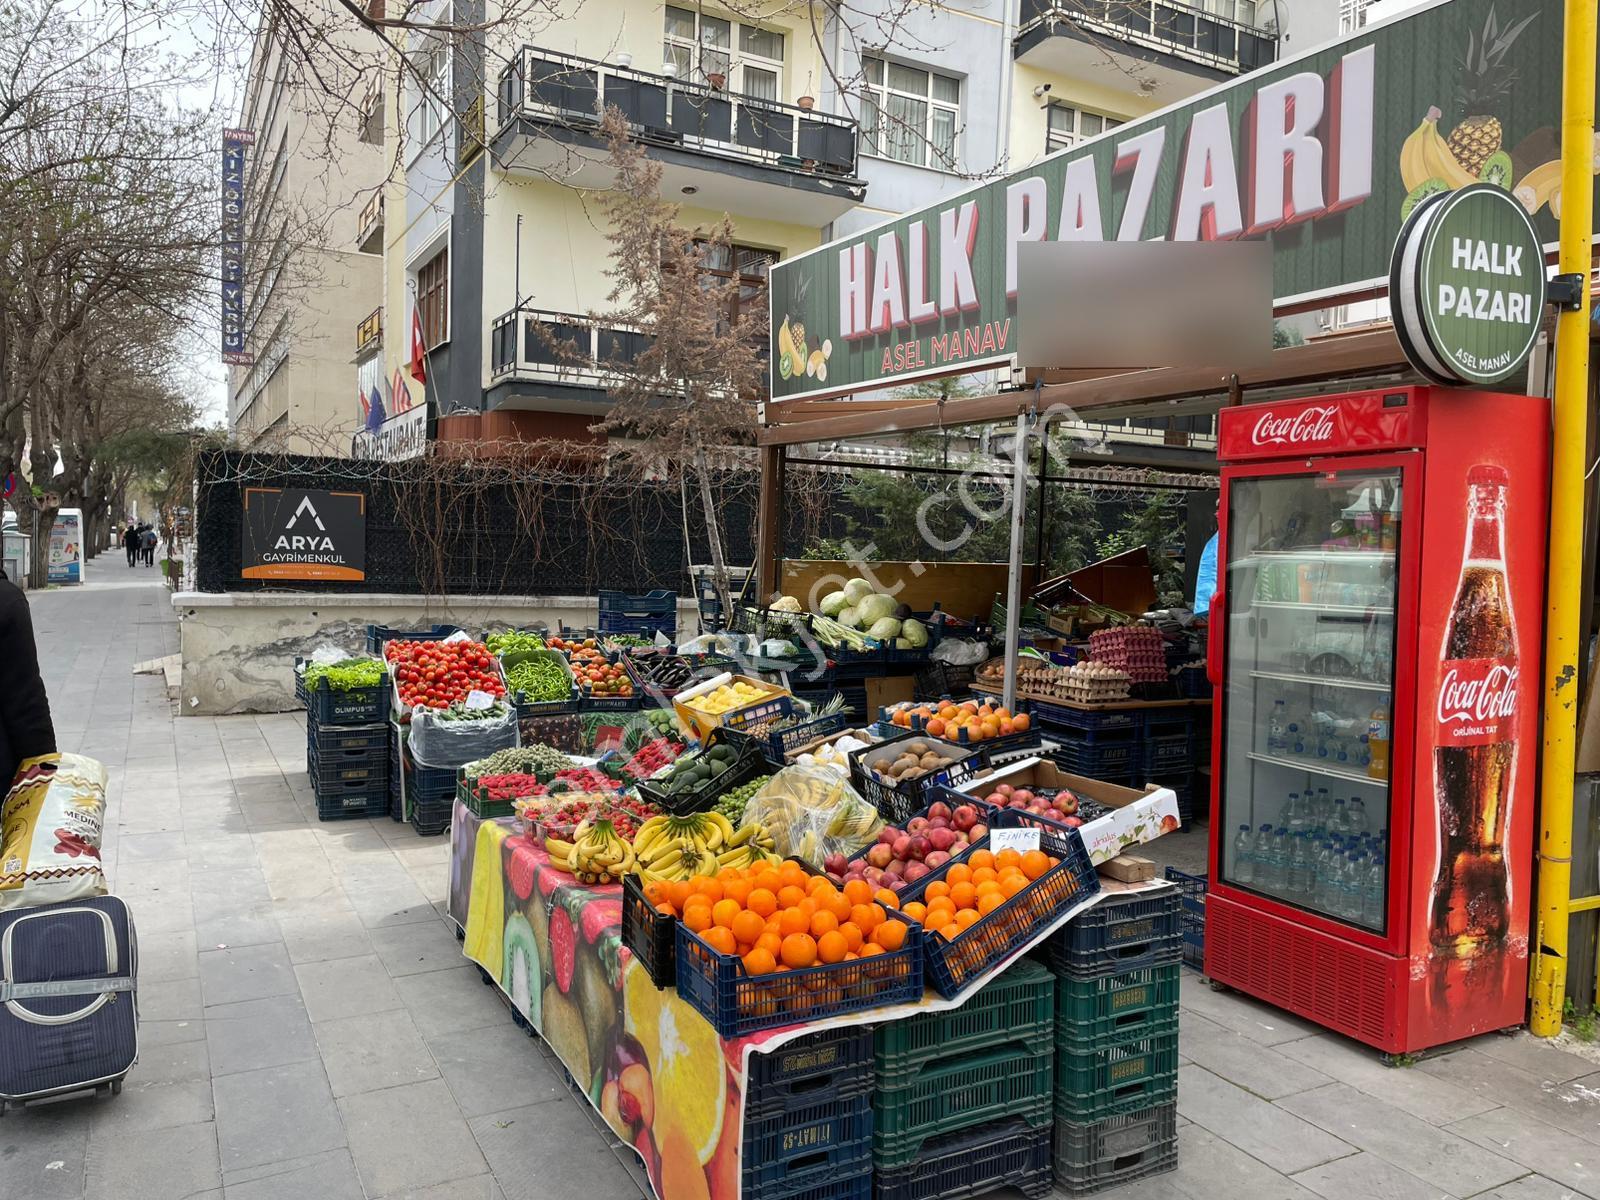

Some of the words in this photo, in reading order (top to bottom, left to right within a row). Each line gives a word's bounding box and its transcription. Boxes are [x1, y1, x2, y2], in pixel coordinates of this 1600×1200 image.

[839, 199, 979, 340] HALK
[1006, 43, 1376, 297] PAZARI
[1452, 237, 1523, 276] HALK
[1438, 284, 1532, 324] PAZARI
[881, 339, 925, 374] ASEL
[931, 318, 1011, 364] MANAV
[1455, 348, 1477, 369] ASEL
[1479, 350, 1511, 371] MANAV
[1251, 405, 1339, 446] Coca-Cola
[263, 552, 346, 564] GAYRİMENKUL
[274, 535, 335, 551] ARYA
[1437, 663, 1519, 723] Coca-Cola
[1486, 725, 1498, 735] TAT
[13, 983, 70, 997] LAGUNA
